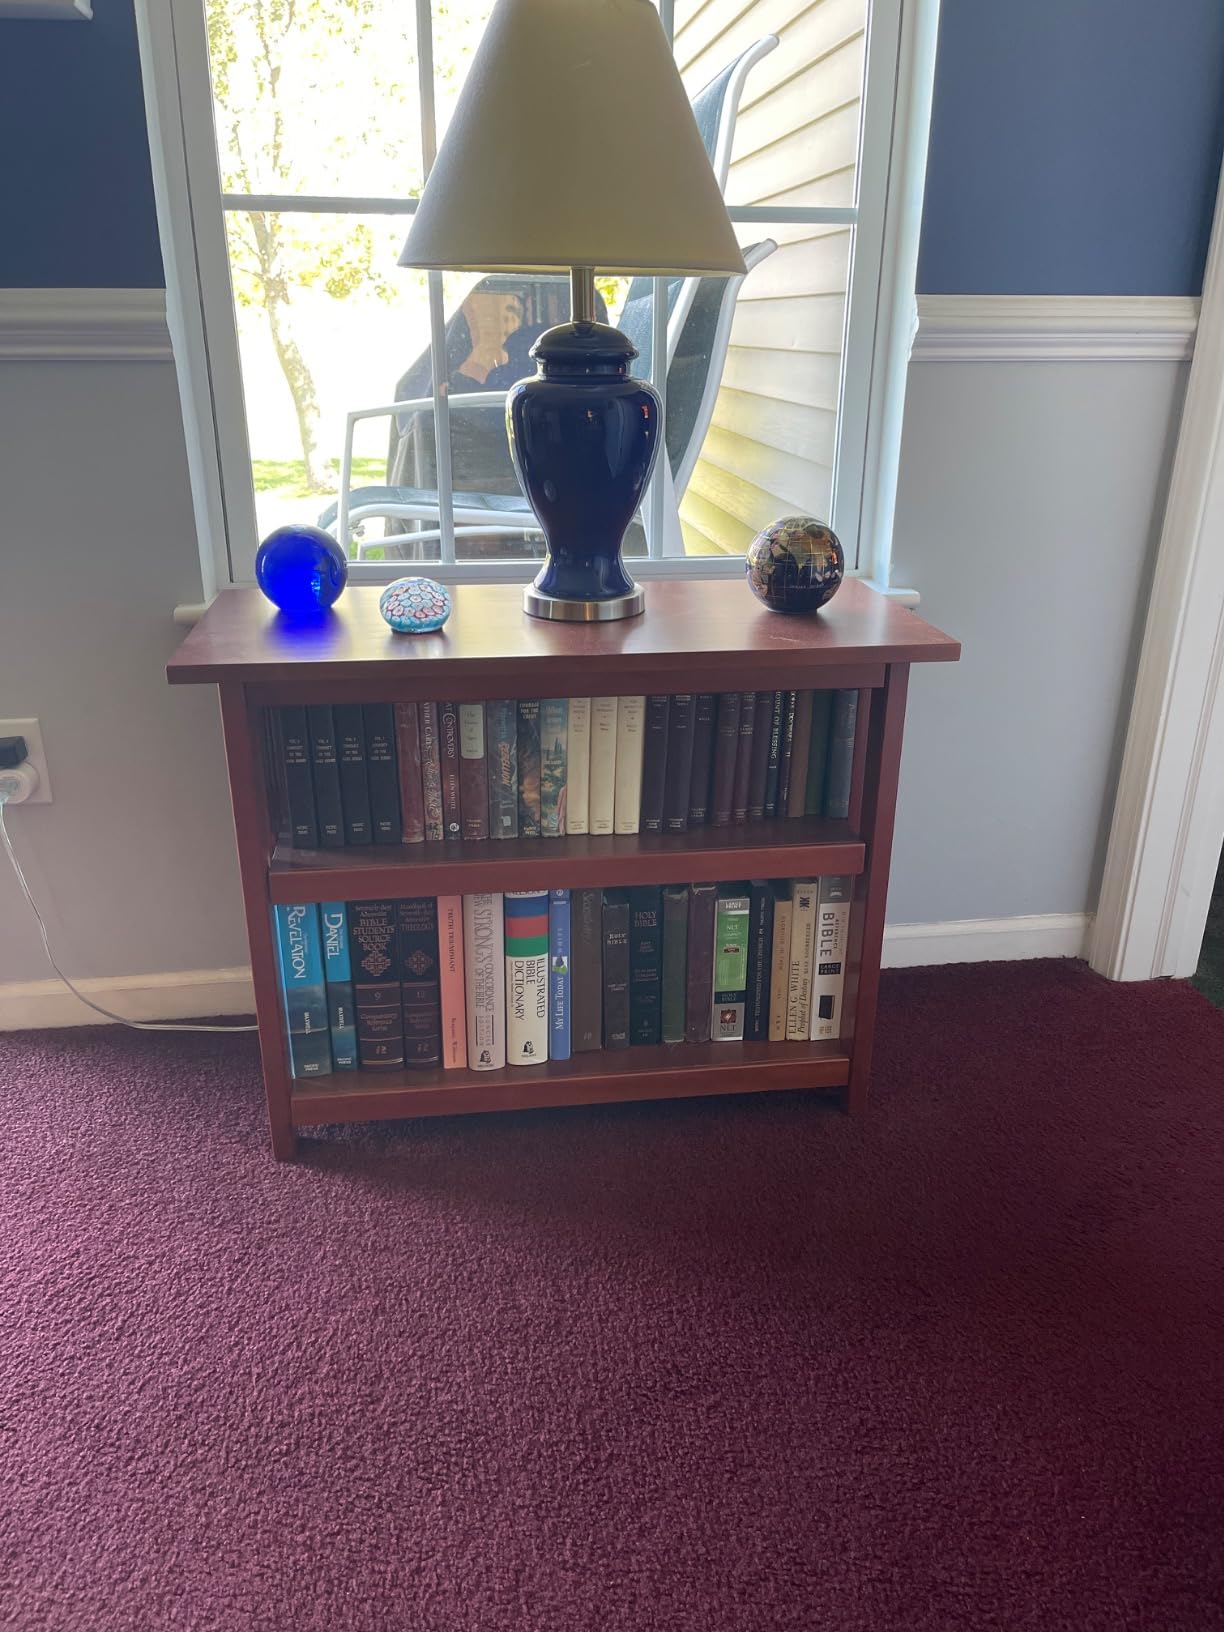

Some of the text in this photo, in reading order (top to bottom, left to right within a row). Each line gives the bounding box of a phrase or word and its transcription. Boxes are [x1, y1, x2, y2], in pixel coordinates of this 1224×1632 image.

[423, 702, 431, 725] ATHER
[774, 692, 782, 713] OUNT
[359, 918, 388, 926] BIBLE
[634, 911, 657, 919] HOLY
[634, 918, 657, 927] BIBLE
[287, 906, 306, 979] REVELATION
[324, 912, 343, 959] DANIEL
[362, 942, 387, 951] BOOK
[819, 912, 835, 957] BIBLE
[525, 960, 536, 985] BIBLE
[791, 960, 800, 993] WHITE
[484, 963, 495, 1012] CONCORDANCE
[513, 960, 525, 1021] DICTIONARY
[536, 957, 547, 1018] ILLUSTRATED
[788, 1005, 798, 1034] ELLEN
[797, 1010, 808, 1034] Prophet
